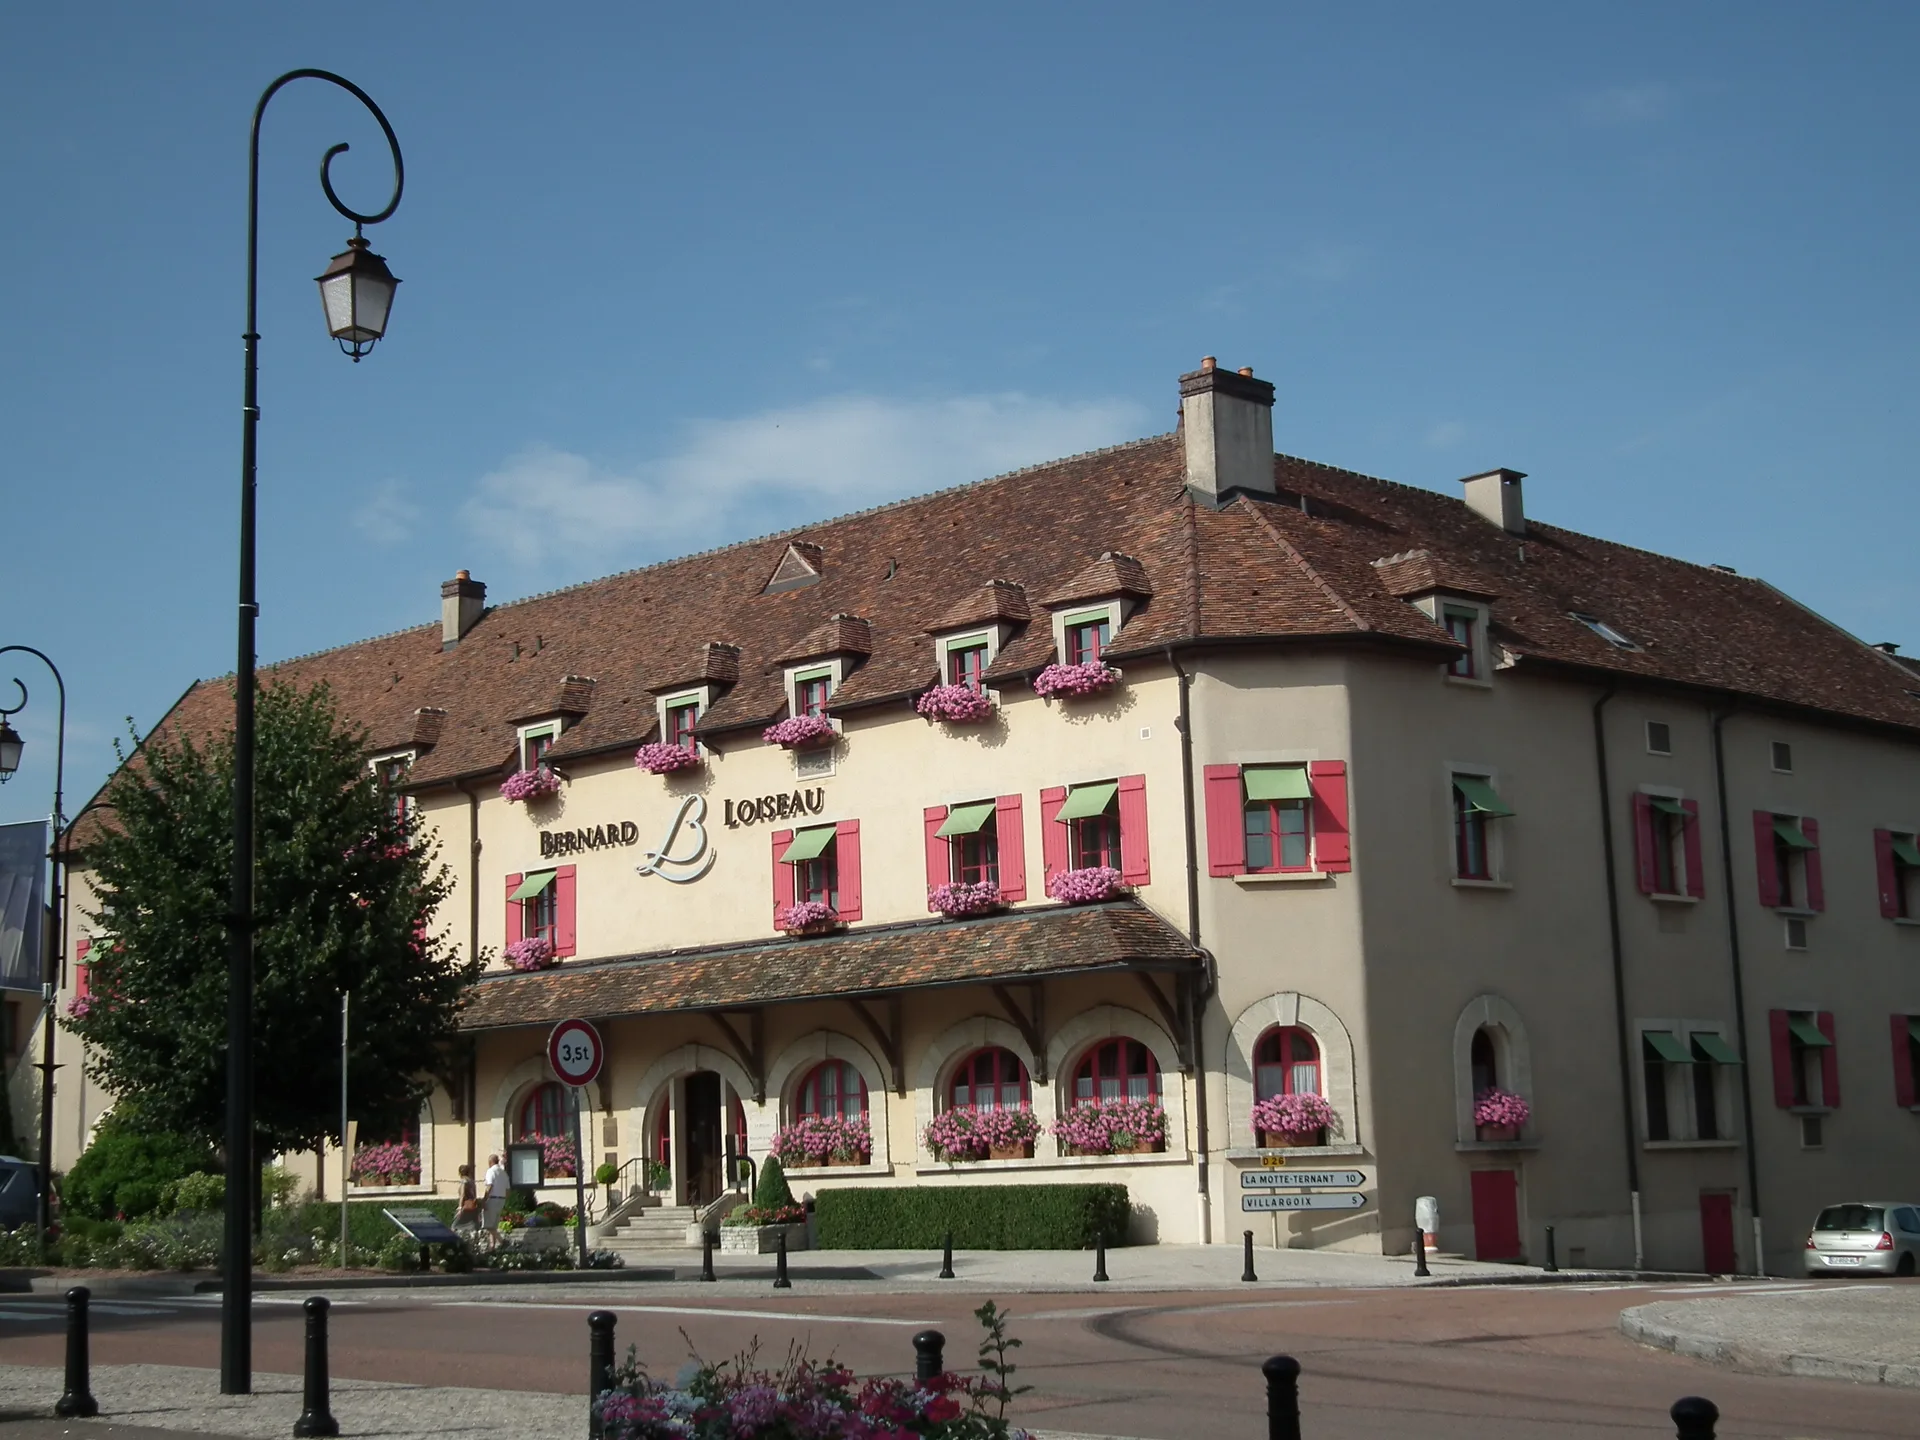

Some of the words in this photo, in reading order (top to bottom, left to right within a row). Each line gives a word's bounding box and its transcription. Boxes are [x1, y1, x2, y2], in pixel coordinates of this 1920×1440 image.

[724, 787, 824, 829] LOISEAU
[540, 821, 638, 857] BERNARD
[562, 1044, 589, 1063] 3,5t
[1262, 1157, 1269, 1165] D
[1271, 1156, 1285, 1165] 26
[1245, 1175, 1257, 1184] LA
[1259, 1174, 1335, 1184] MOTTE-TERNANT
[1345, 1174, 1356, 1183] 10
[1246, 1197, 1312, 1207] VILLARGOIX
[1351, 1196, 1357, 1205] 5
